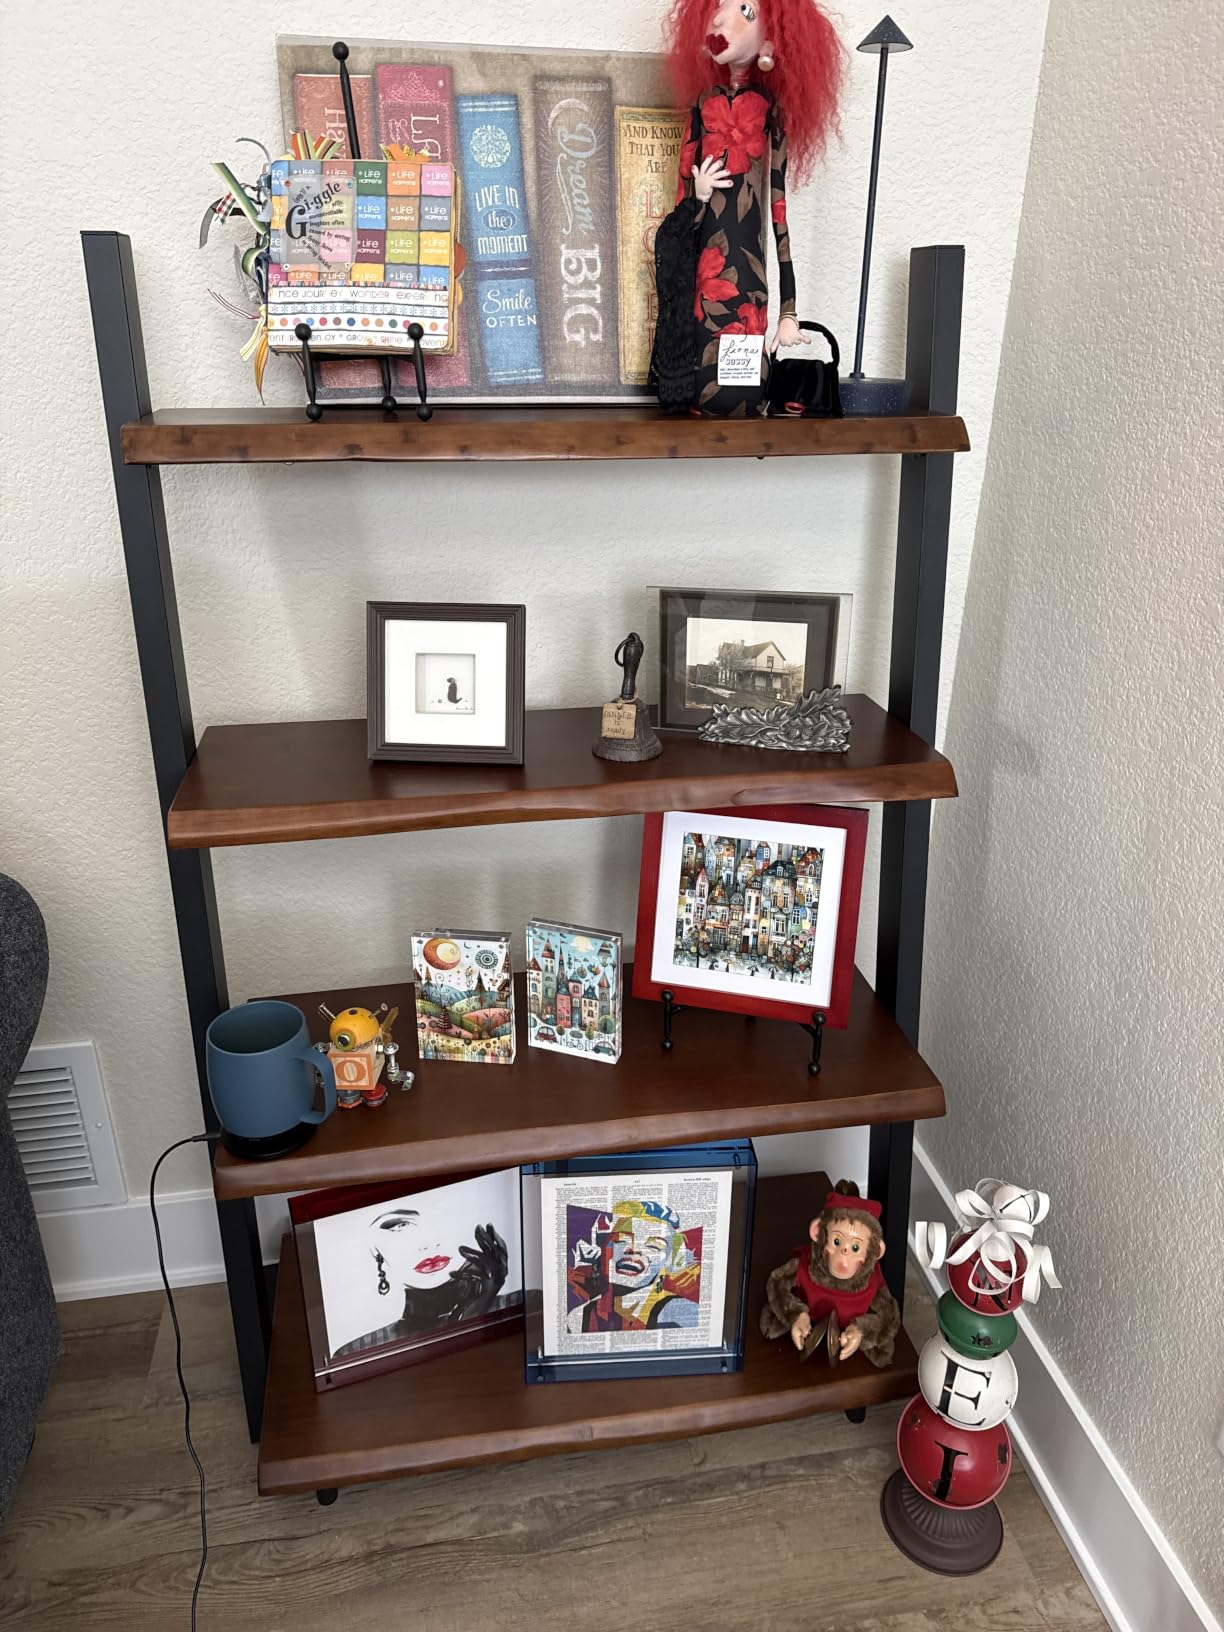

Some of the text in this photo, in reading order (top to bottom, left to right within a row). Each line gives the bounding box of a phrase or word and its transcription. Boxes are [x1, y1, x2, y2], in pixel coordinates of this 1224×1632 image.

[624, 125, 684, 140] AND KNOW
[628, 142, 680, 157] THAT YOU
[646, 160, 668, 174] ARE
[475, 185, 501, 212] LIVE
[487, 211, 513, 230] the
[477, 235, 528, 255] MOMENT
[482, 288, 533, 314] Smile
[560, 243, 604, 347] BIG
[486, 315, 537, 328] OFTEN
[933, 1349, 992, 1427] E
